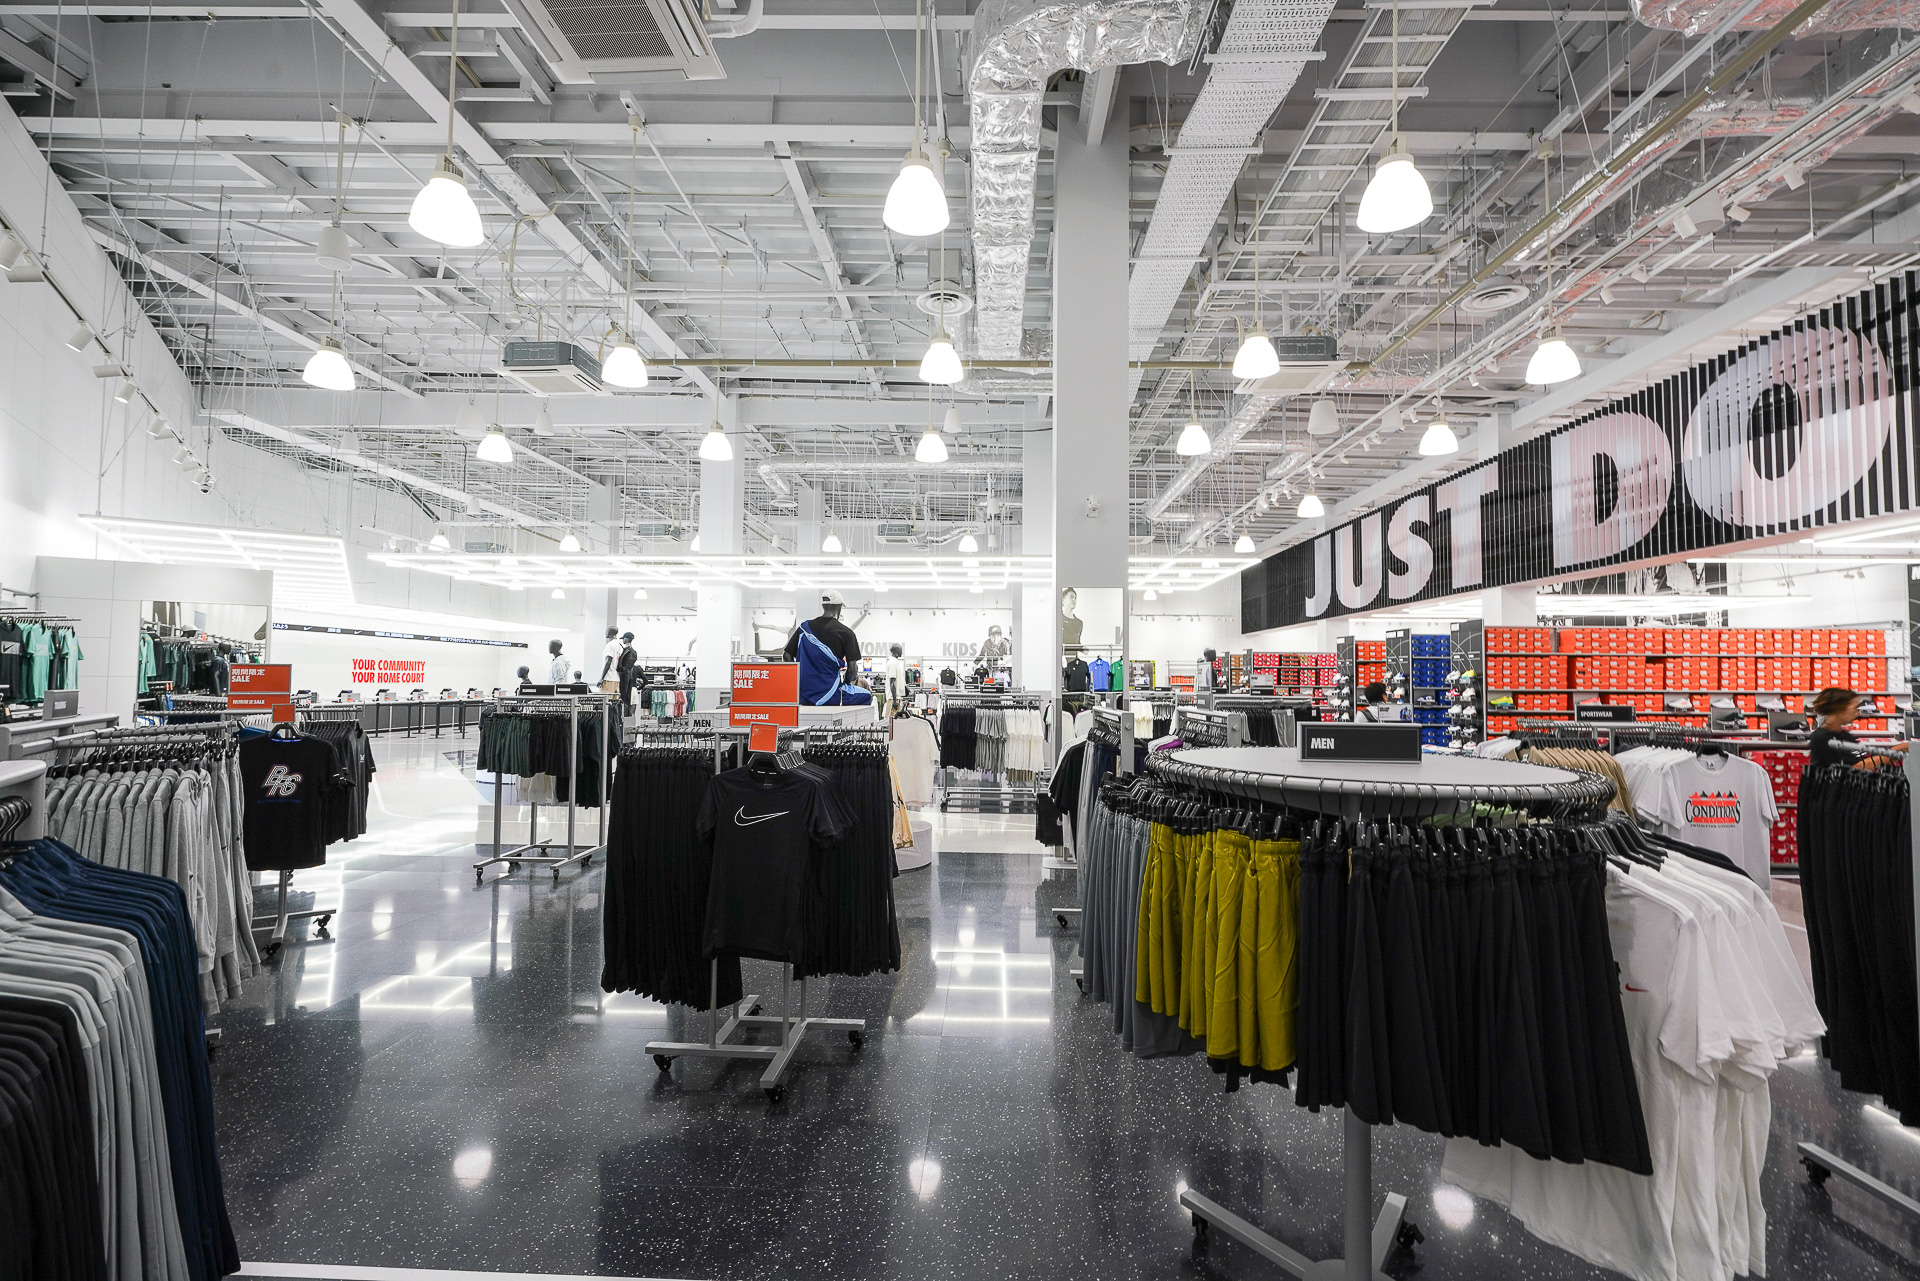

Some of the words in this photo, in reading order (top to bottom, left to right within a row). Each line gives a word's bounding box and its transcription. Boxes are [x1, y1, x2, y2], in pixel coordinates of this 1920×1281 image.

[1305, 462, 1499, 617] JUST
[1552, 326, 1891, 568] DO
[942, 642, 978, 656] KIDS
[352, 658, 376, 670] YOUR
[378, 660, 425, 671] COMMUNITY
[352, 671, 375, 683] YOUR
[377, 672, 400, 683] HOME
[401, 672, 425, 683] COURT
[733, 669, 769, 679] 期間限定
[733, 679, 753, 688] SALE
[693, 719, 711, 727] MEN
[1310, 738, 1335, 749] MEN
[1685, 799, 1741, 824] CONDITIONS
